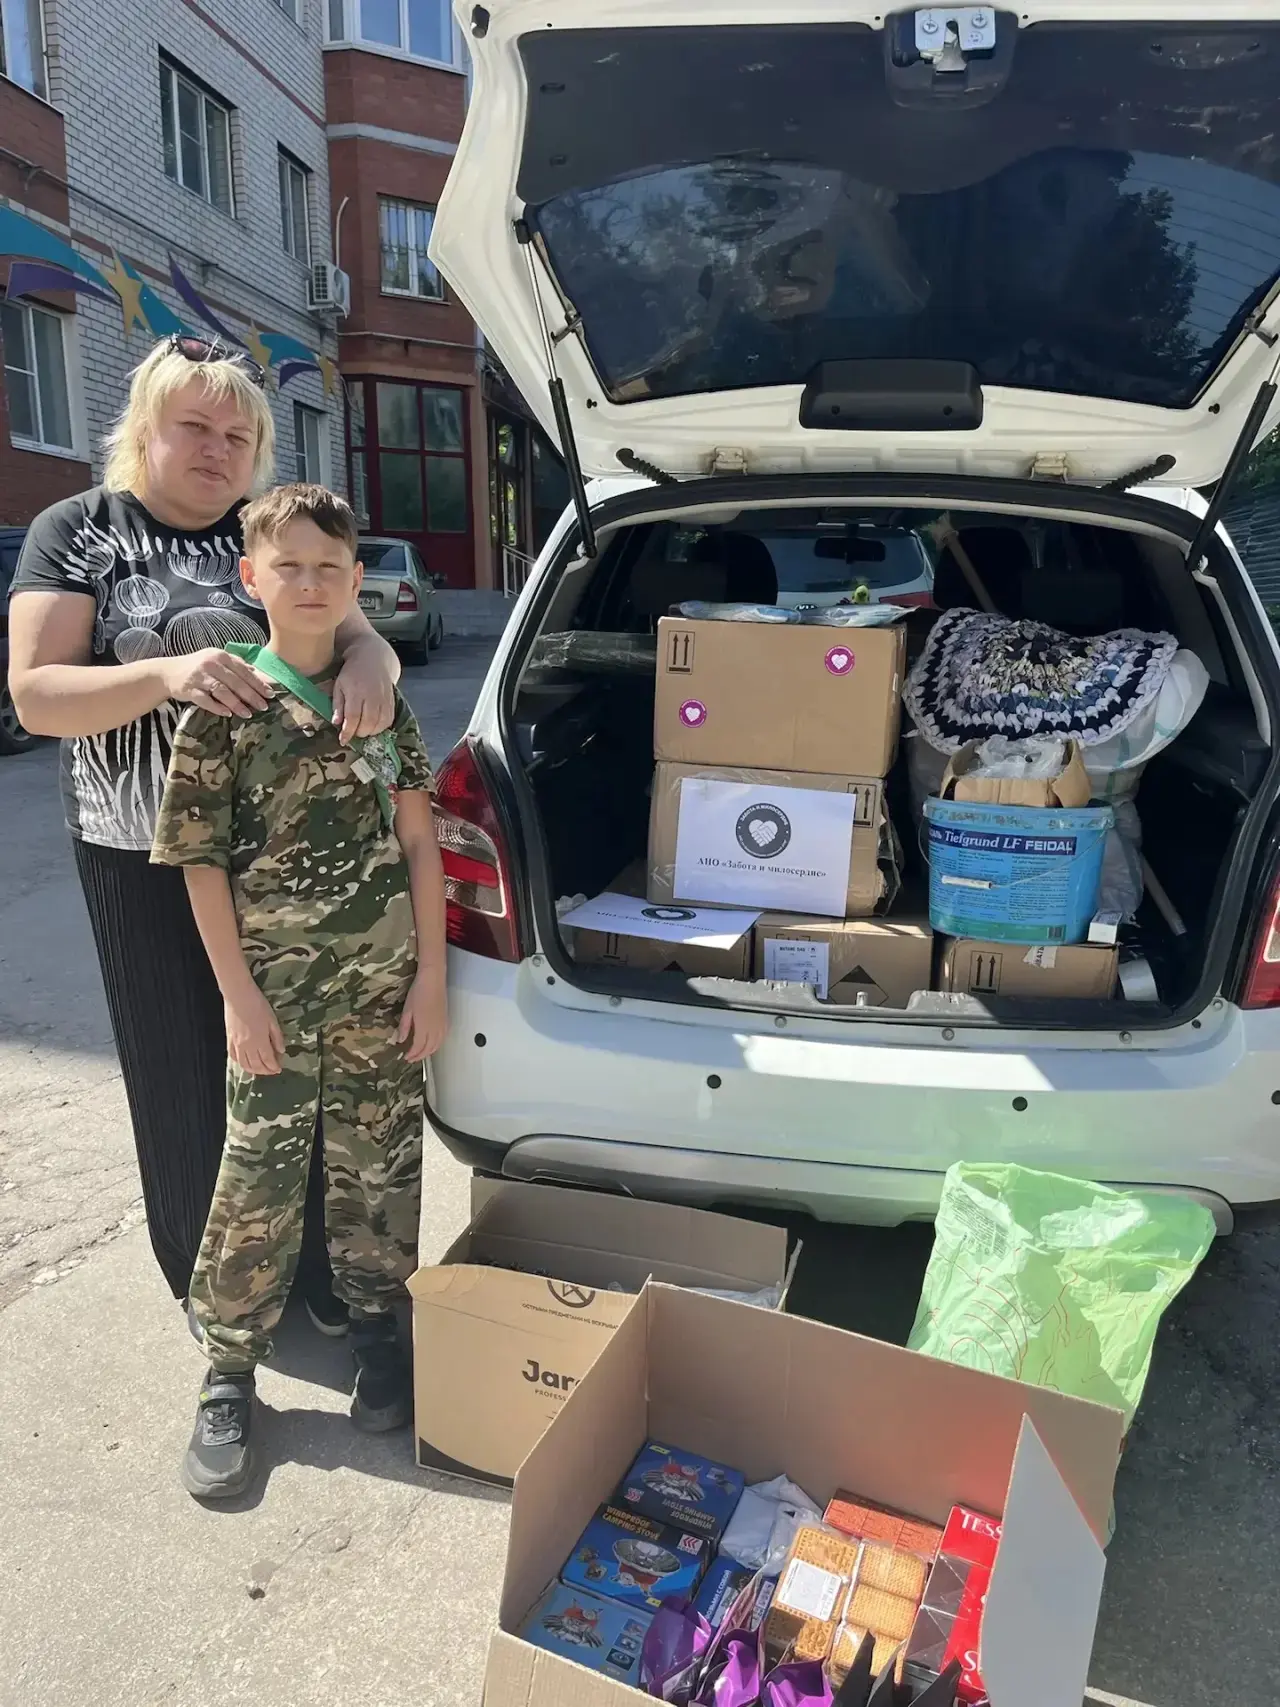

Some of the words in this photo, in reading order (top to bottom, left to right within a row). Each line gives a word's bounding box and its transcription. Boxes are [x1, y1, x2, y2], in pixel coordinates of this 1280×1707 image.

[944, 829, 999, 848] Tiefgrund
[1002, 837, 1022, 850] LF
[1024, 840, 1073, 853] FEIDAL
[697, 857, 720, 867] АНО
[721, 859, 757, 872] «Забота
[767, 866, 827, 879] милосердие»
[521, 1358, 581, 1391] Jar
[534, 1387, 568, 1402] PROFESS
[606, 1505, 652, 1529] WINDPROOF
[683, 1506, 716, 1523] CAMPING
[602, 1513, 637, 1535] CAMPING
[635, 1526, 661, 1541] STOVE
